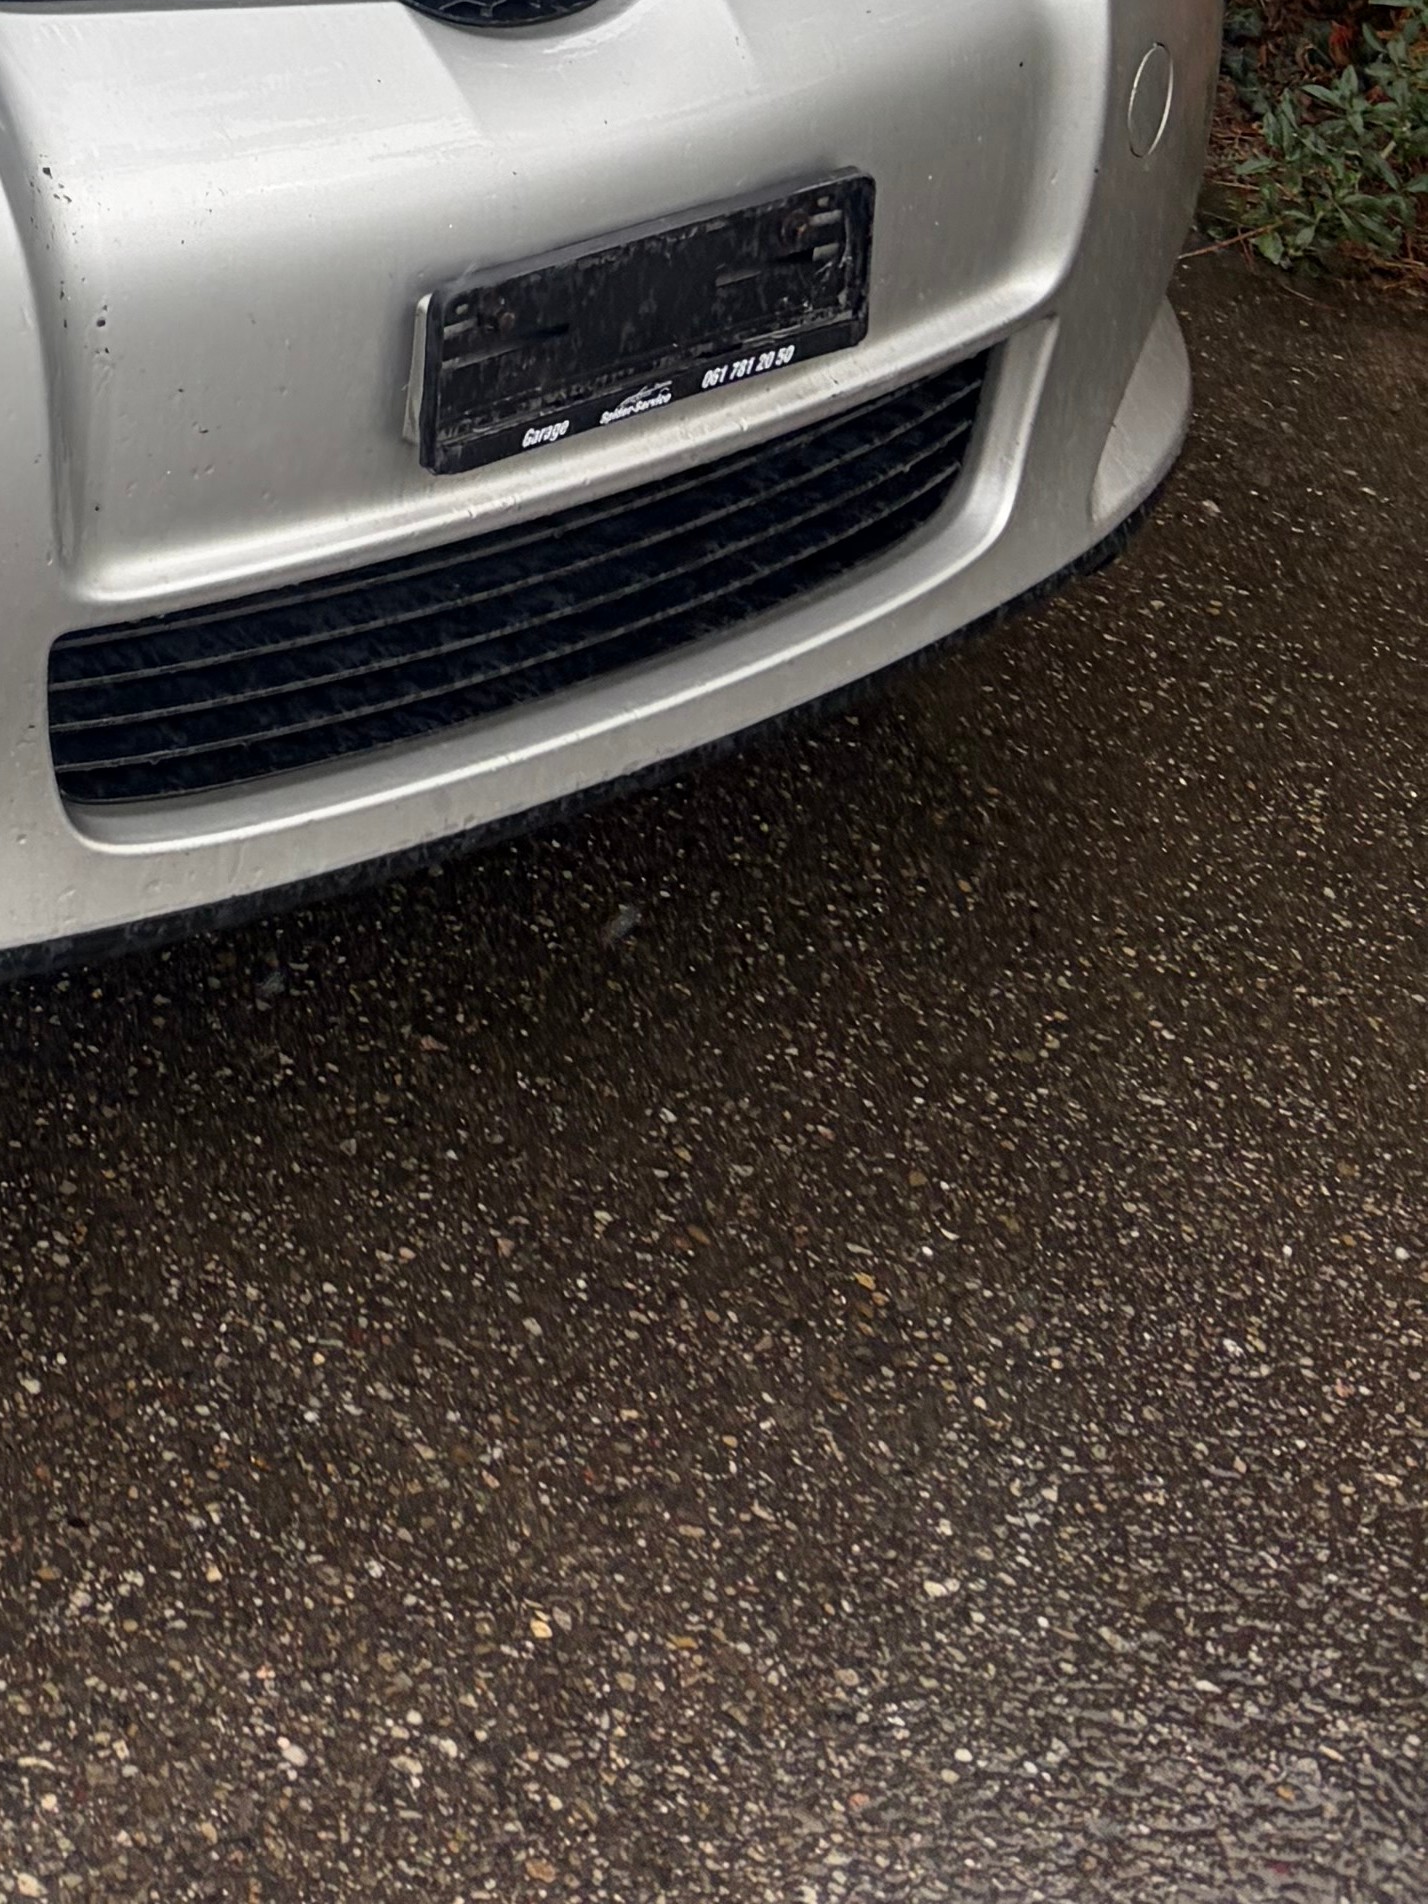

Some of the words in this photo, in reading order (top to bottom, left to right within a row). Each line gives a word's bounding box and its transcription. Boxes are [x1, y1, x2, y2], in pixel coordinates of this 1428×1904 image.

[522, 419, 570, 449] Garage
[701, 364, 729, 389] 061
[729, 356, 758, 381] 781
[755, 350, 777, 372] 20
[775, 344, 796, 367] 50
